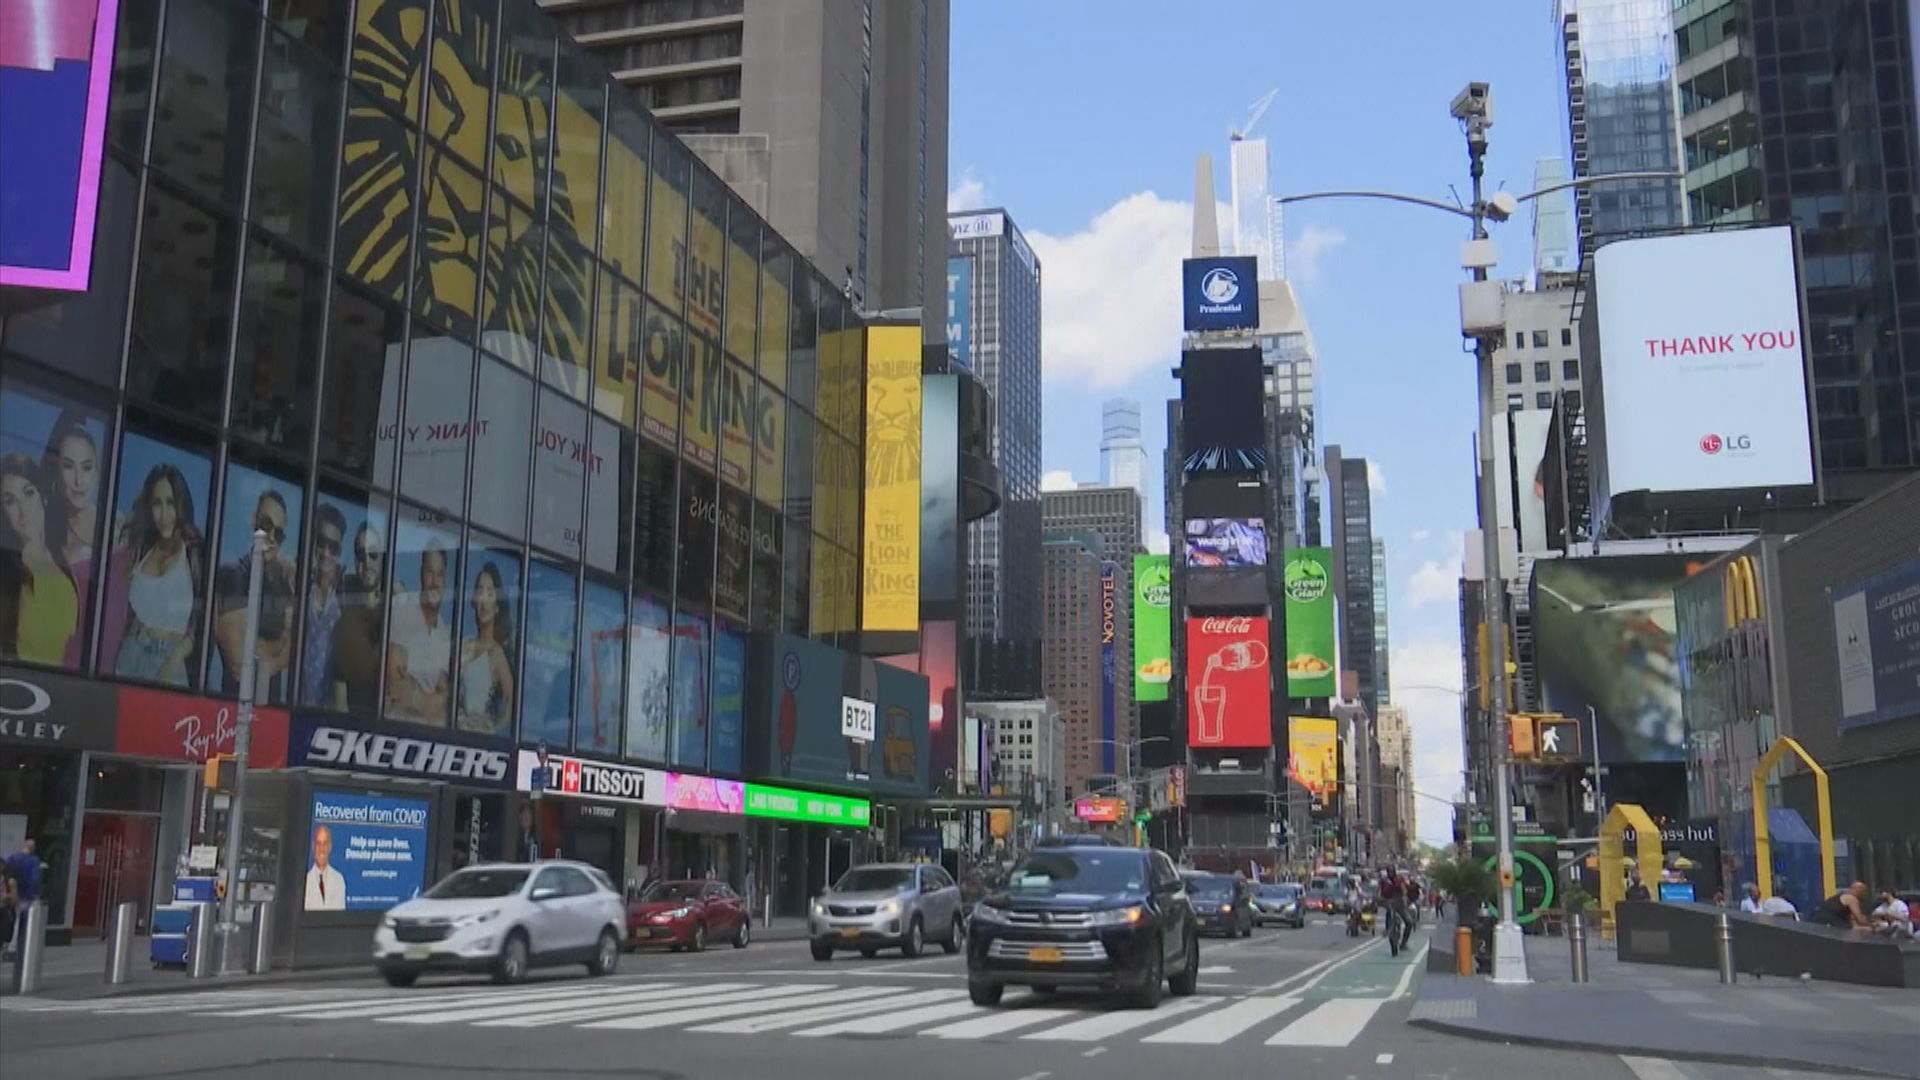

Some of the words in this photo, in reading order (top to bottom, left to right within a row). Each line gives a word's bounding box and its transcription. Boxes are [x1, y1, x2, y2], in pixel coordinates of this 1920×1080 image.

[672, 237, 722, 314] THE
[1199, 303, 1242, 314] Prudential
[608, 258, 695, 401] LION
[700, 328, 776, 450] KING
[1645, 334, 1734, 357] THANK
[1742, 330, 1796, 351] YOU
[1727, 435, 1751, 450] LG
[876, 524, 904, 541] THE
[869, 541, 910, 565] LION
[866, 567, 915, 595] KING
[1289, 578, 1324, 589] Green
[1292, 588, 1324, 599] Giant
[1102, 572, 1114, 644] NOVOTEL
[846, 706, 872, 732] BT21
[175, 707, 258, 757] Ray-Ba
[306, 726, 510, 781] SKECHERS
[582, 768, 644, 798] TISSOT
[315, 802, 368, 820] Recovered
[369, 805, 392, 822] from
[393, 808, 427, 825] COVID?
[350, 835, 367, 849] Help
[368, 838, 377, 847] us
[377, 839, 393, 848] save
[1688, 825, 1715, 841] hut
[346, 848, 371, 860] Donate
